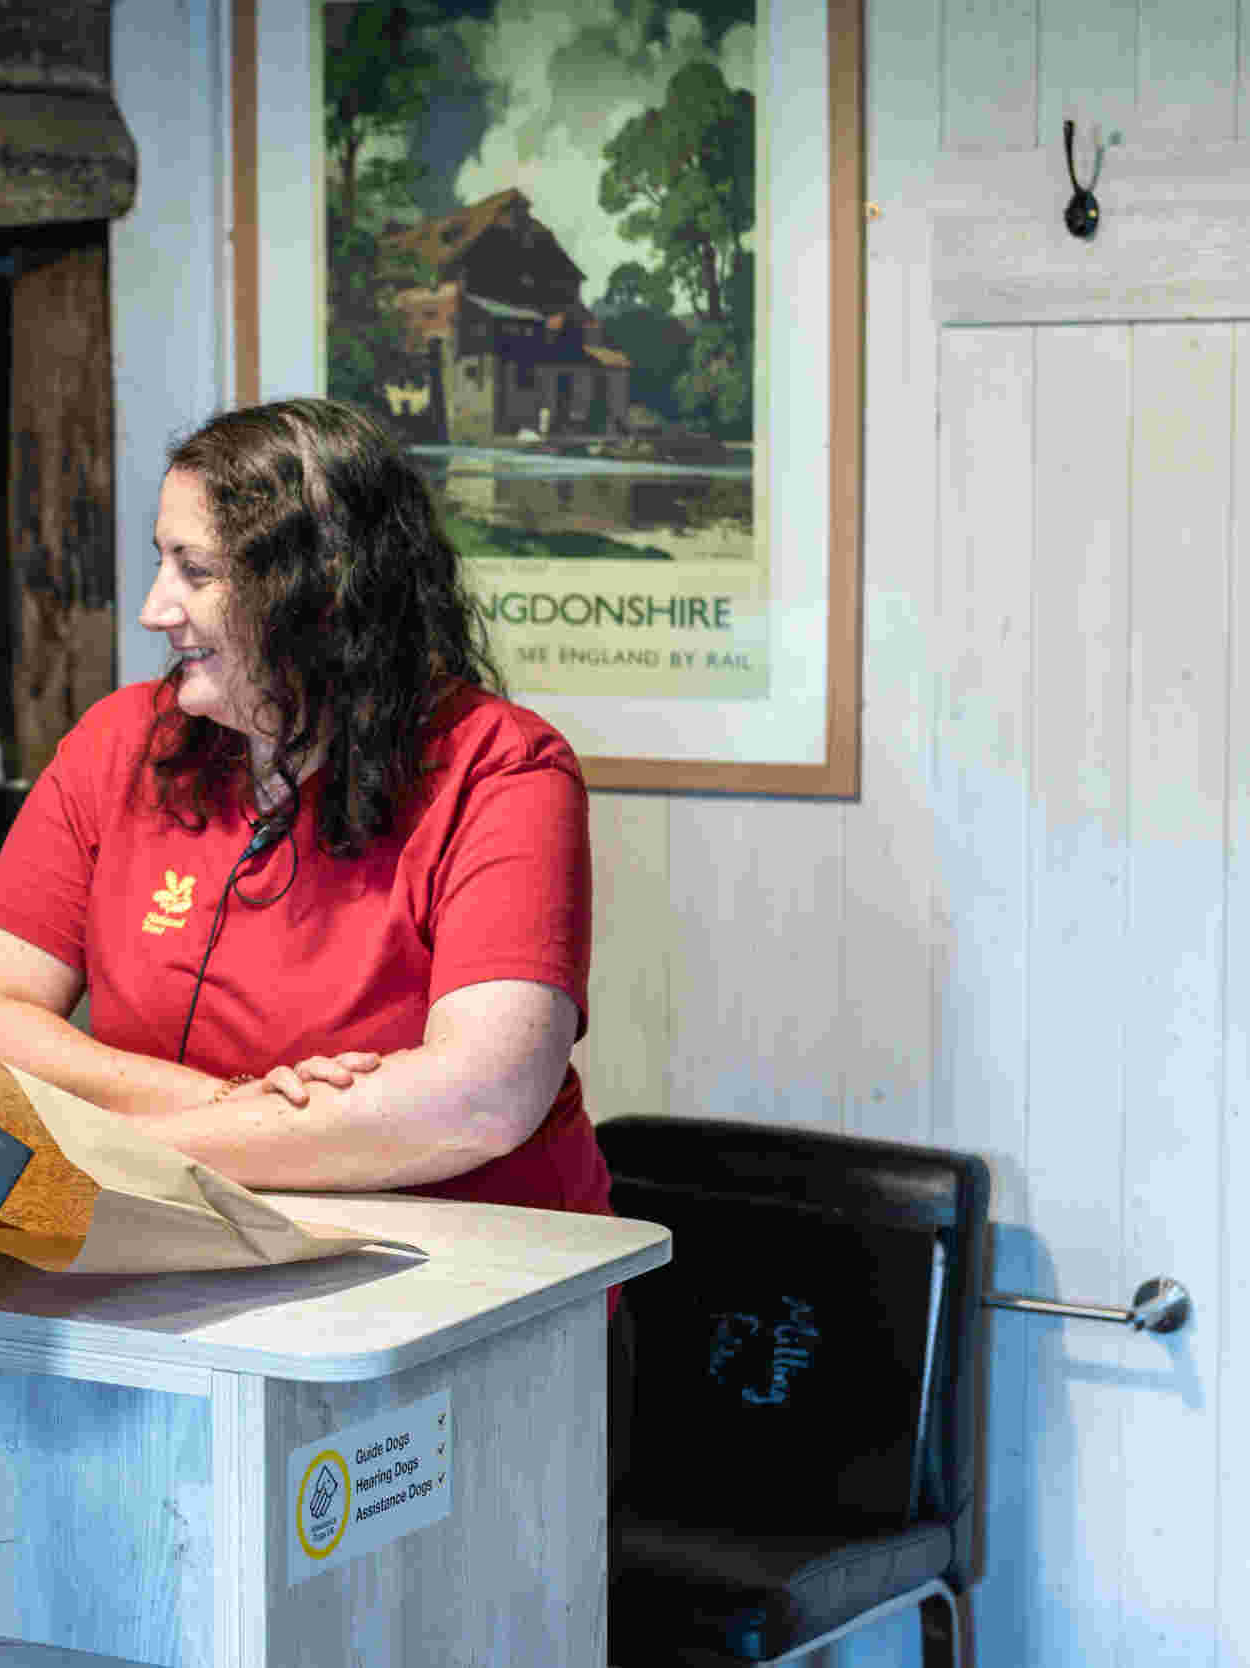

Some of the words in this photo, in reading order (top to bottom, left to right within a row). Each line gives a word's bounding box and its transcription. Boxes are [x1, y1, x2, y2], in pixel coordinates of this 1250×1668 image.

[558, 648, 660, 668] ENGLAND
[669, 651, 695, 669] BY
[706, 651, 753, 672] RAIL
[356, 1442, 384, 1465] Guide
[386, 1432, 411, 1453] Dogs
[356, 1469, 392, 1496] Hearing
[394, 1457, 420, 1478] Dogs
[356, 1491, 407, 1522] Assistance
[408, 1479, 434, 1499] Dogs
